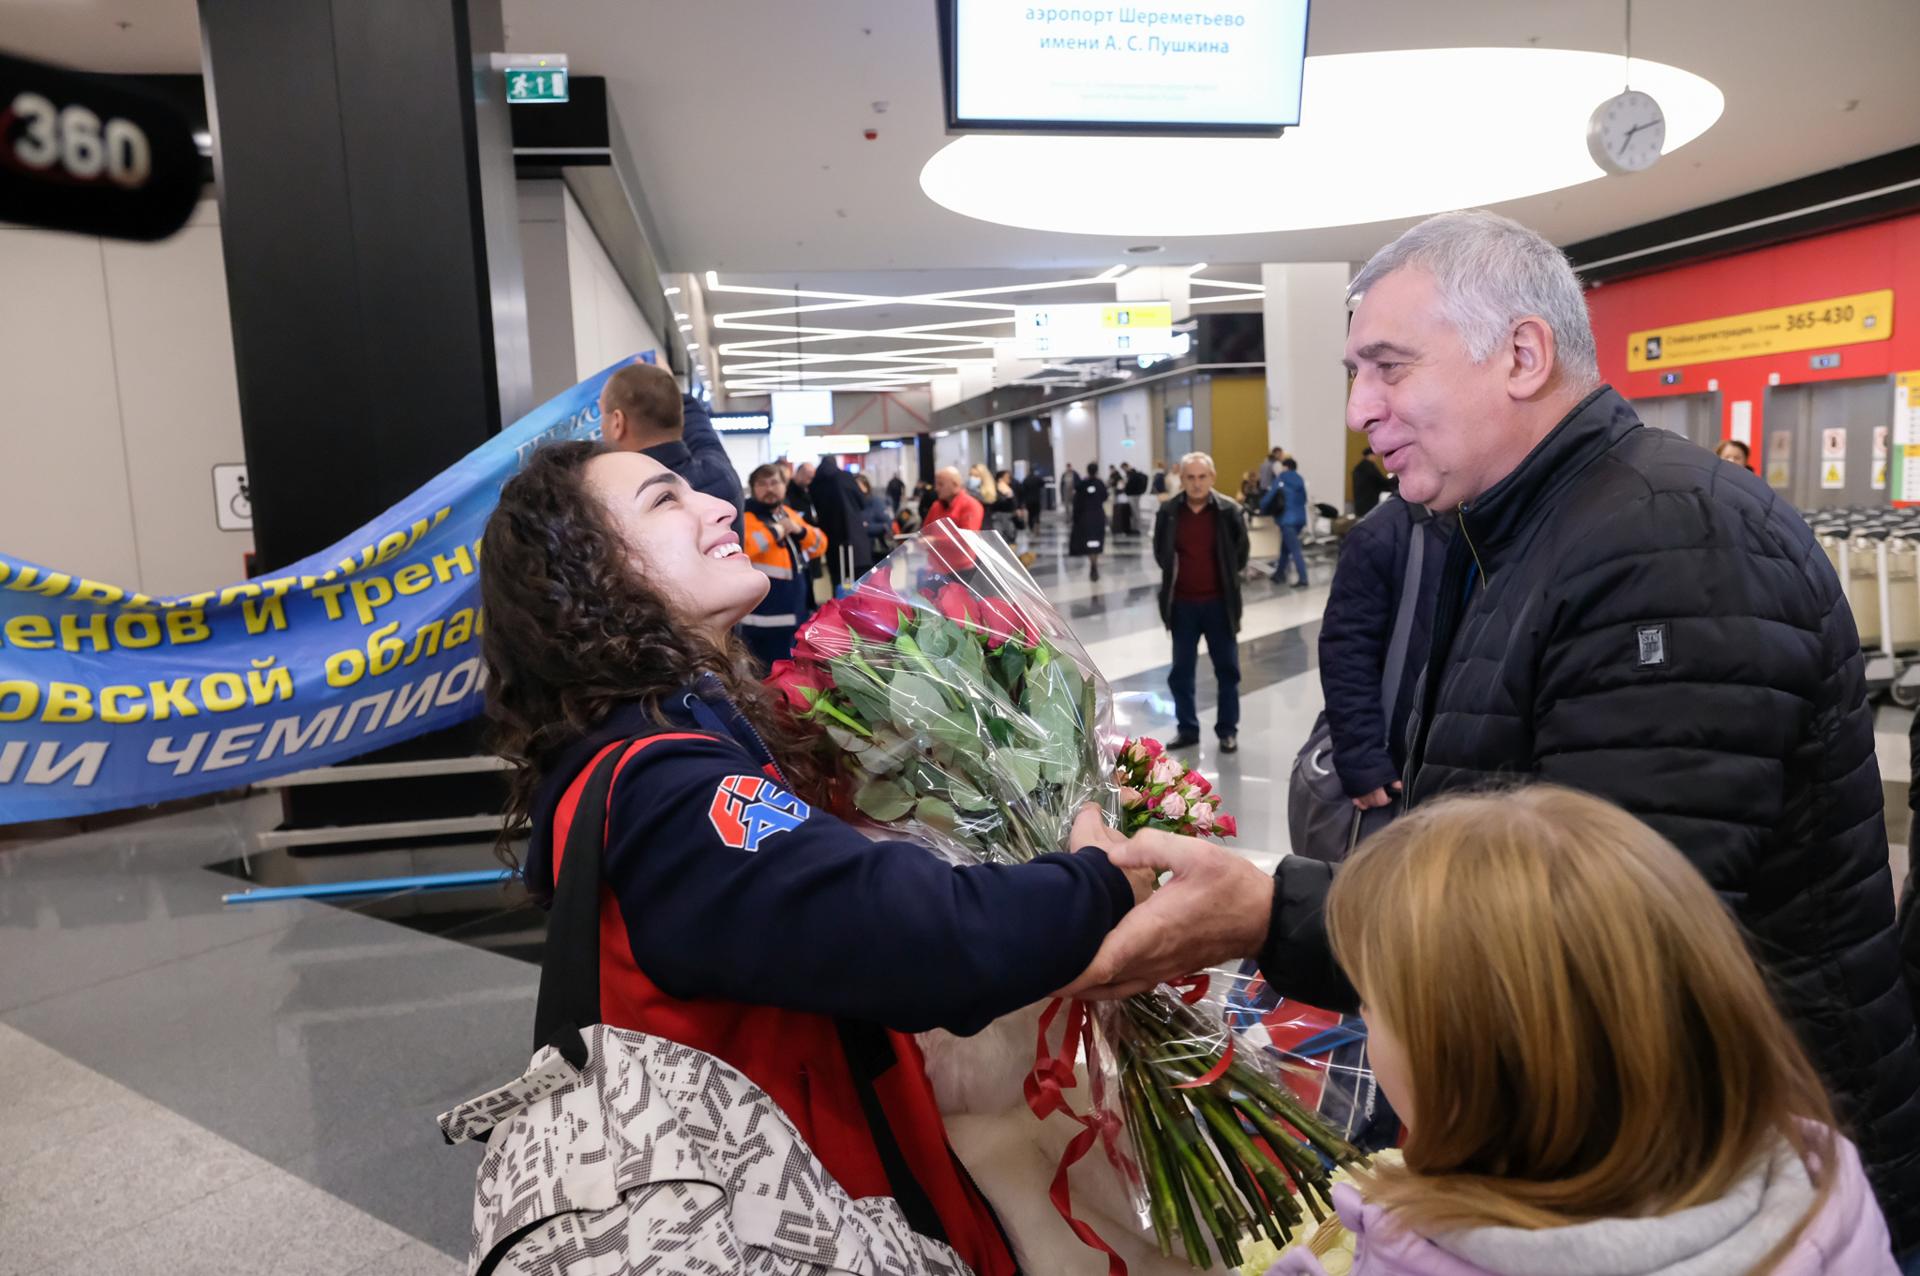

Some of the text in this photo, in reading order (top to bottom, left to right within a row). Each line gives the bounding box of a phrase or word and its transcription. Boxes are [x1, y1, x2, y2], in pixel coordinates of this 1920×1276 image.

[1025, 7, 1246, 28] аэропорт Шереметьево
[1039, 35, 1230, 56] имени А. С. Пушкина
[11, 91, 151, 189] 360
[1786, 305, 1854, 332] 365-430
[0, 610, 210, 652] енов
